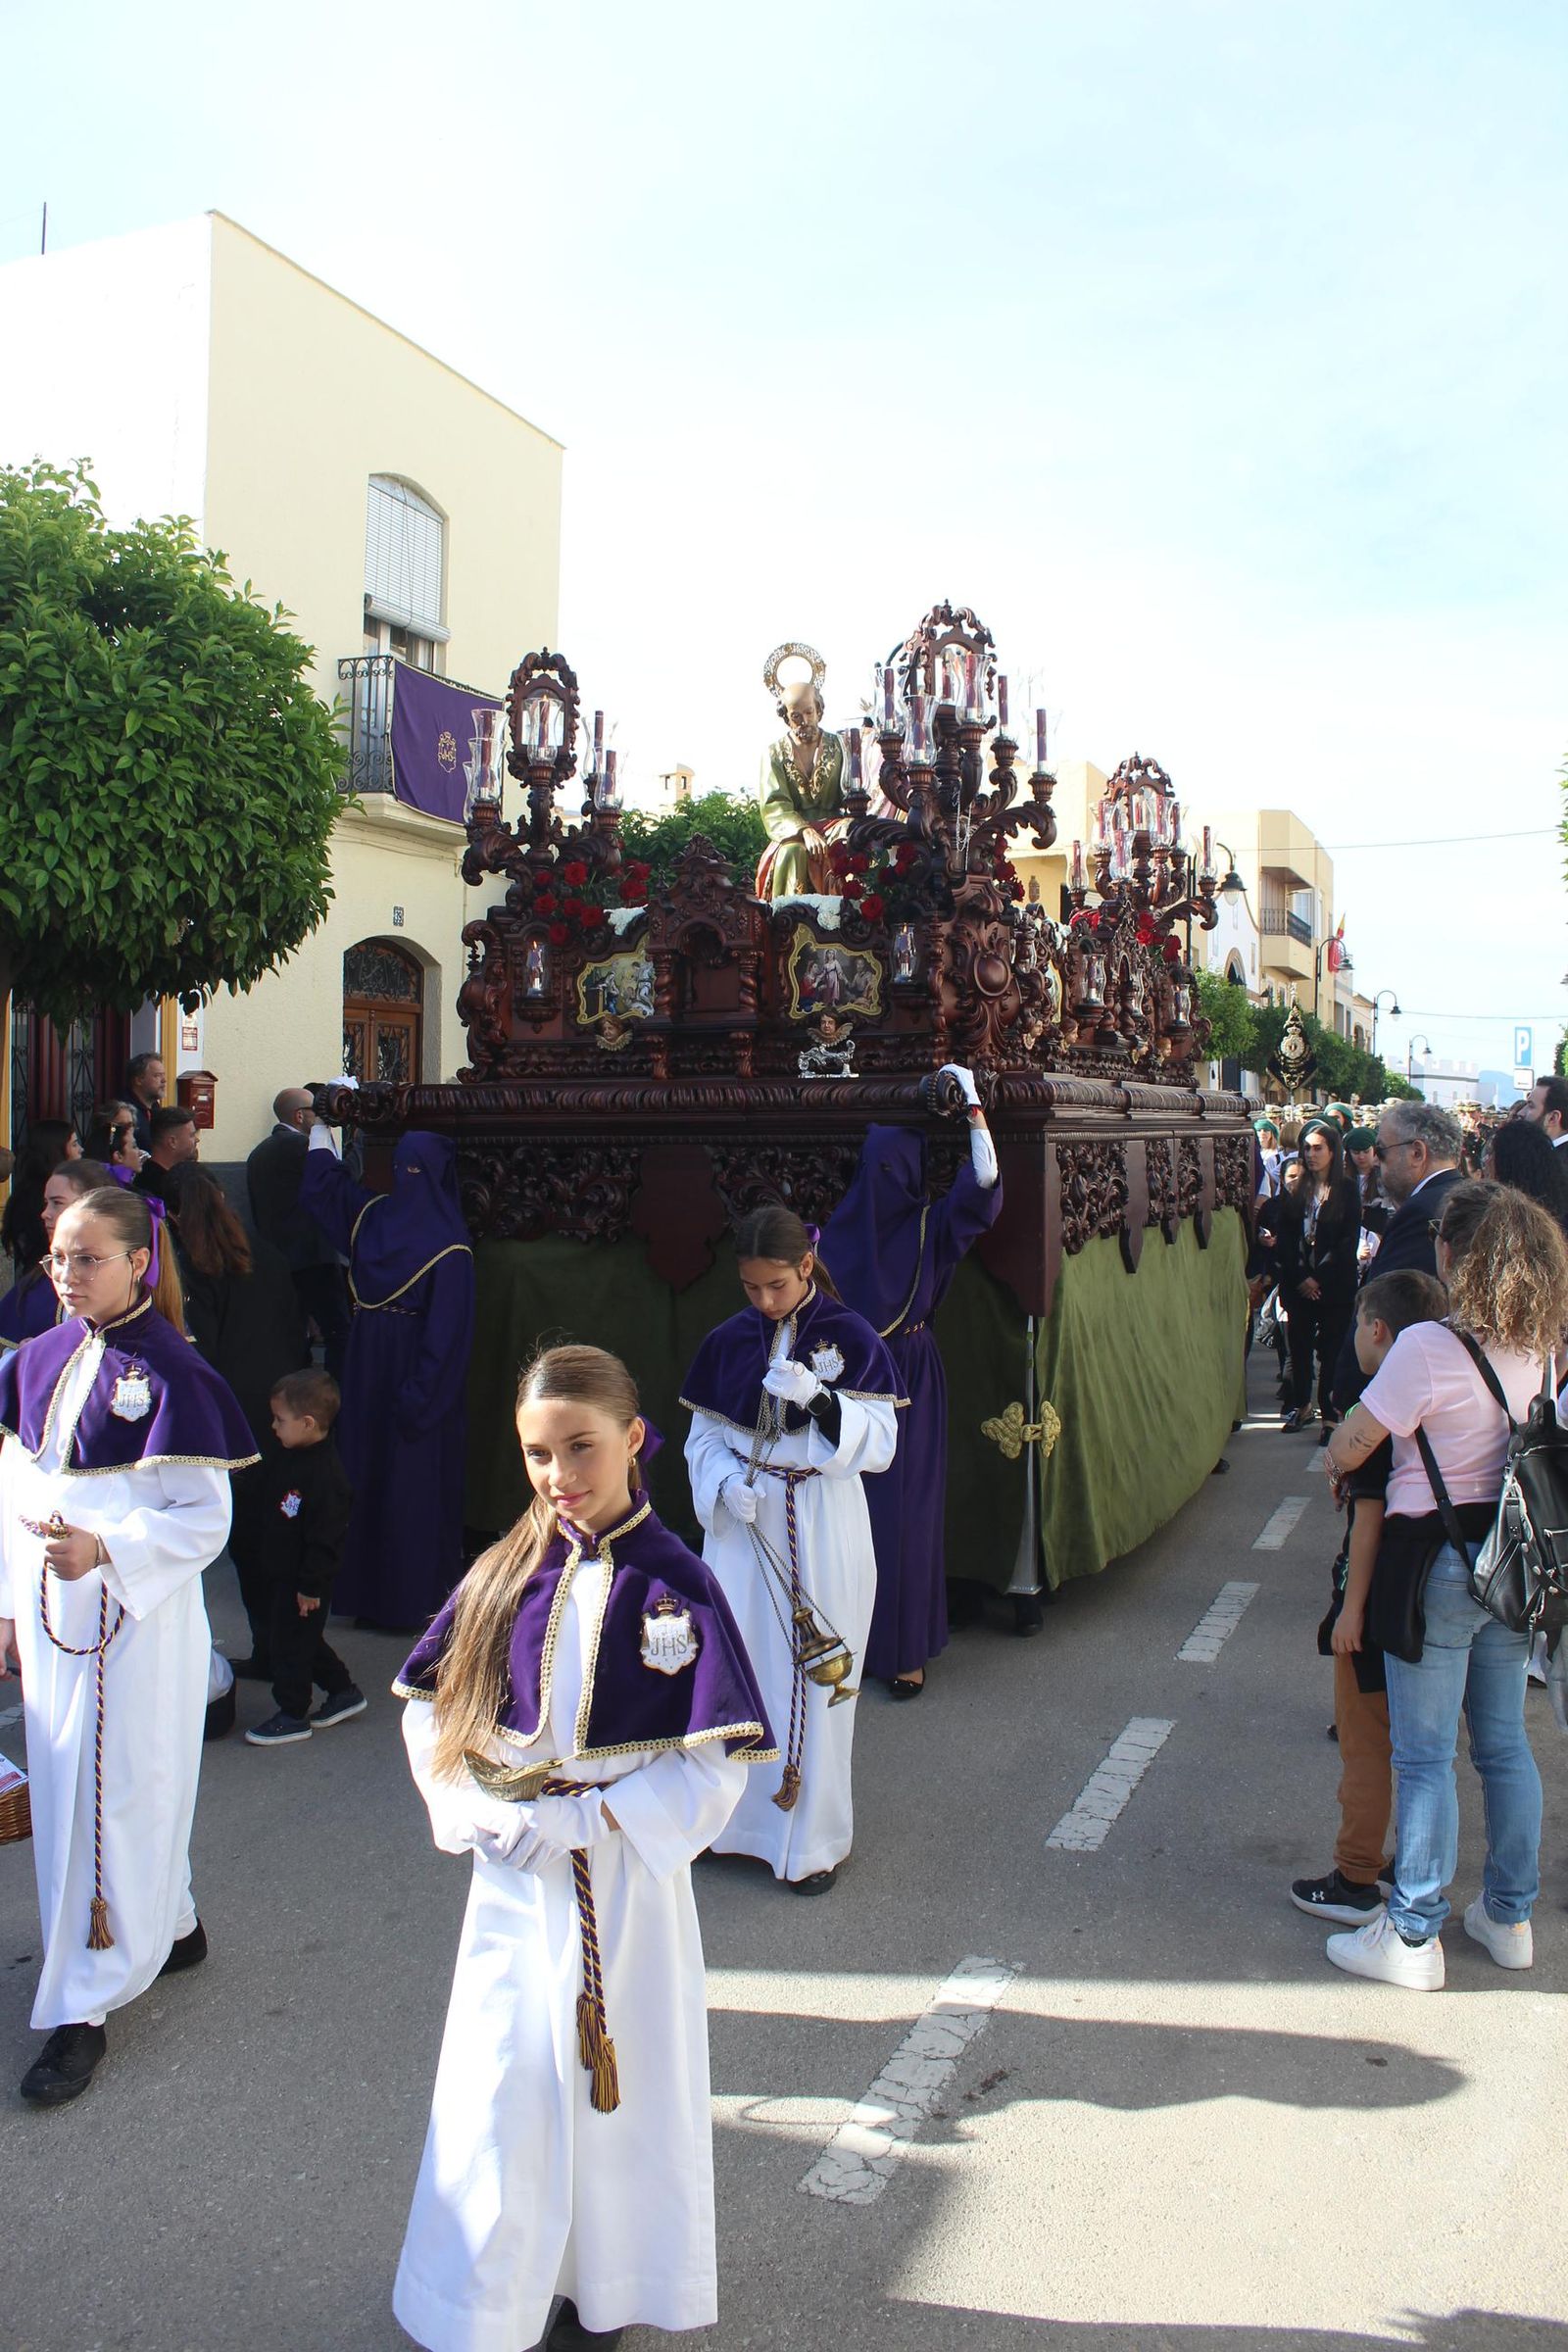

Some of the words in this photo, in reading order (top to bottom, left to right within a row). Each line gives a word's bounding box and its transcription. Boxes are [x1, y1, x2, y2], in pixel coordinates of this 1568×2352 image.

[1516, 1030, 1530, 1064] P
[817, 1357, 840, 1374] JHS
[119, 1393, 145, 1408] JHS
[650, 1635, 688, 1657] JHS
